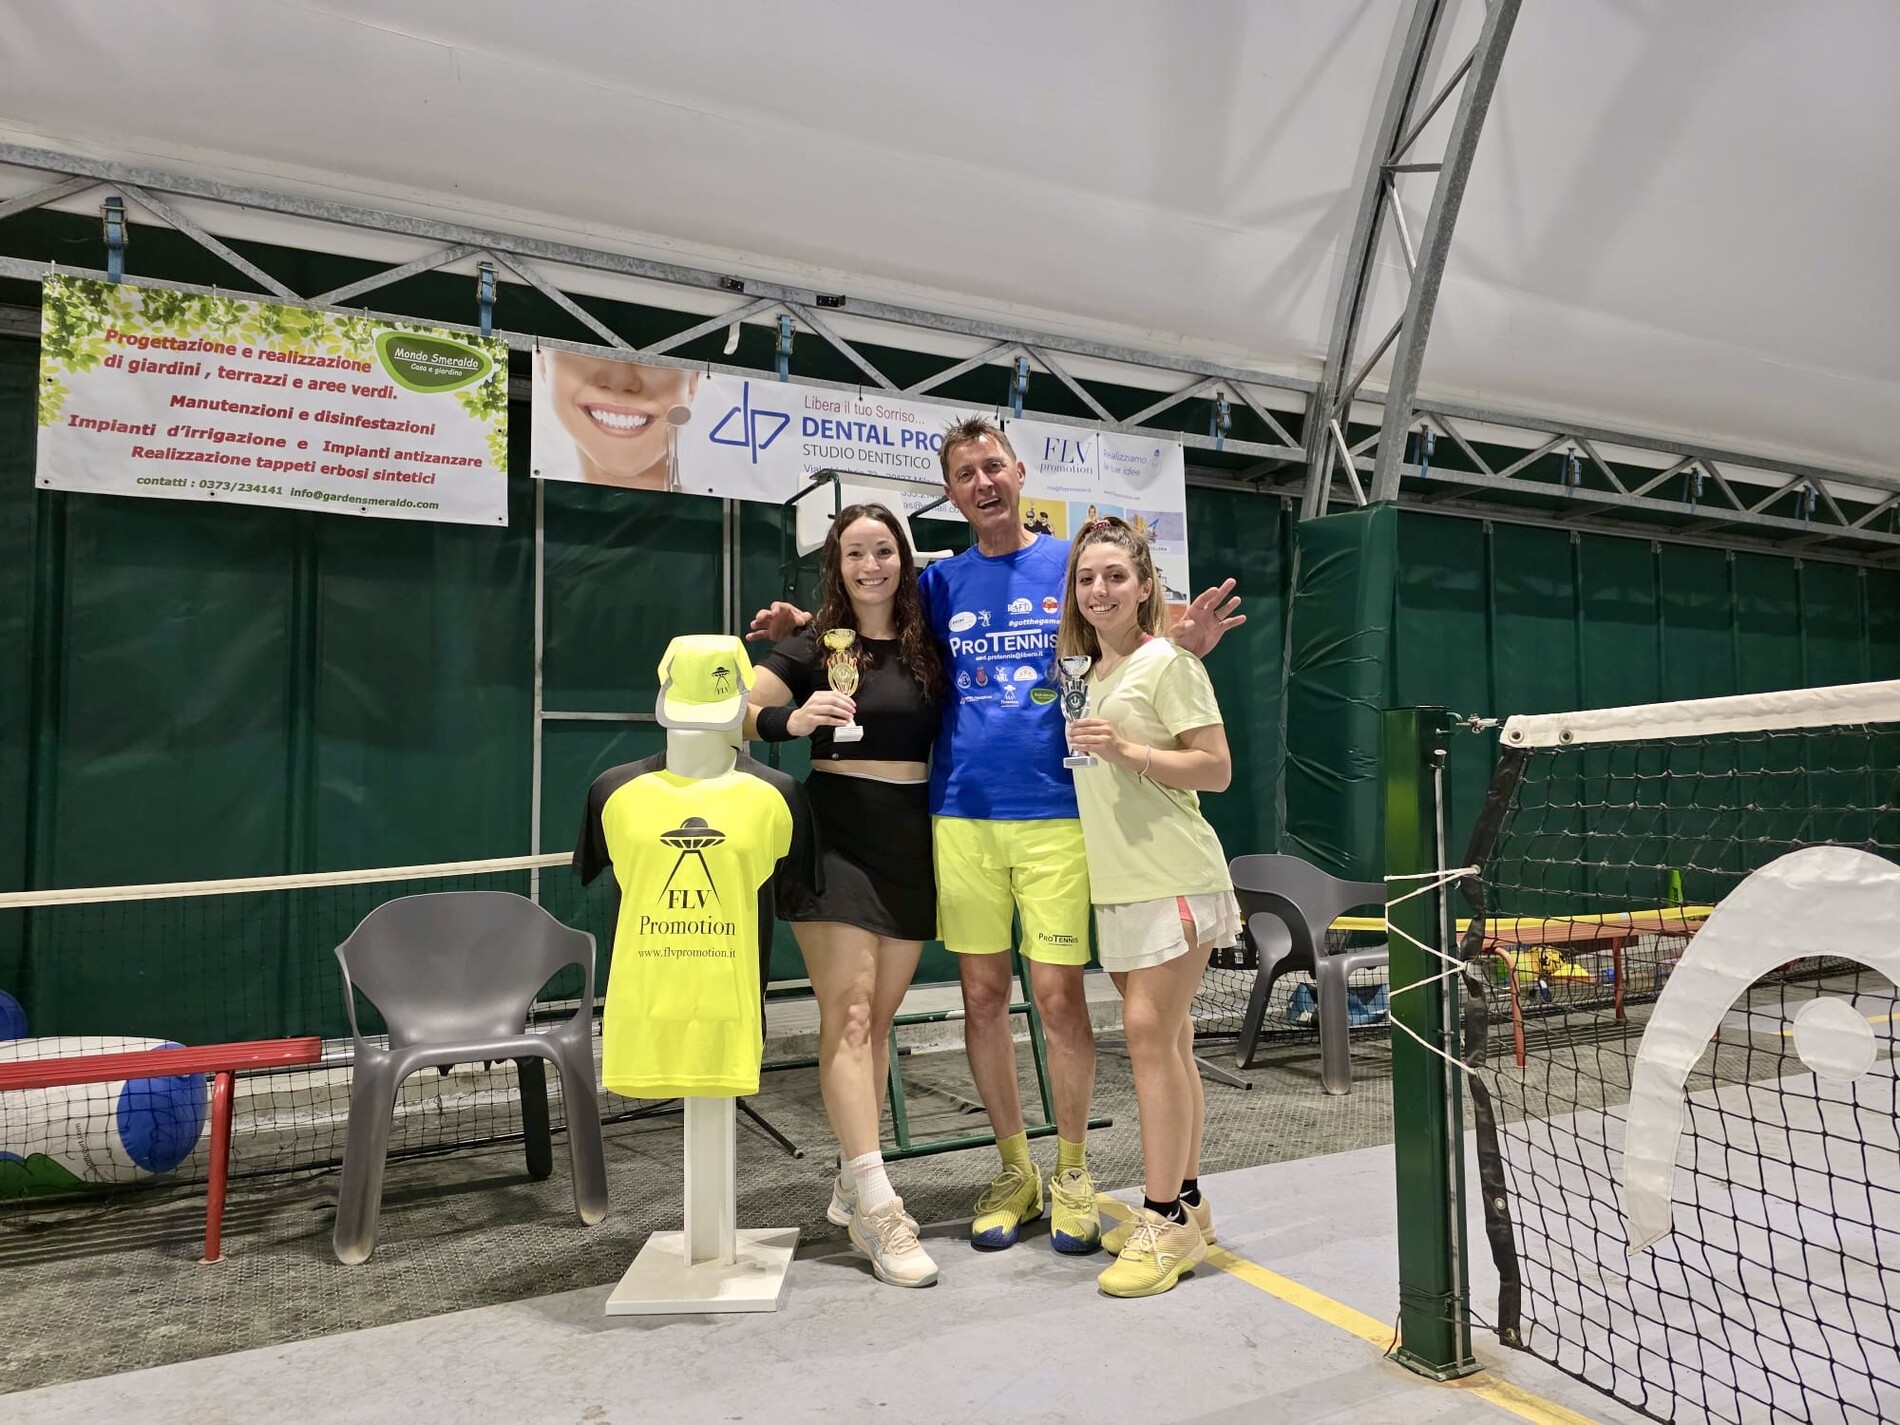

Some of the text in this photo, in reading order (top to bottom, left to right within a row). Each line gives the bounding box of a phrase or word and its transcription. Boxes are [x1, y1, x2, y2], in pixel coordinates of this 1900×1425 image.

[104, 329, 373, 373] Progettazione e realizzazione
[394, 347, 479, 368] Mondo Smeraldo
[104, 354, 123, 369] di
[128, 358, 202, 377] giardini
[217, 365, 288, 387] terrazzi
[292, 376, 304, 389] e
[308, 379, 347, 393] aree
[351, 384, 398, 400] verdi.
[411, 363, 427, 372] Casa
[434, 367, 462, 377] giardino
[169, 395, 436, 436] Manutenzioni e disinfestazioni
[804, 395, 925, 425] Libera il tuo Sorriso...
[67, 414, 157, 436] Impianti
[297, 438, 309, 450] e
[322, 440, 391, 460] Impianti
[394, 448, 483, 468] antizanzare
[802, 416, 944, 452] DENTAL PRO
[803, 444, 931, 470] STUDIO DENTISTICO
[1043, 436, 1094, 464] FLV
[1103, 449, 1148, 464] Realizziamo
[131, 446, 436, 485] Realizzazione tappeti erbosi sintetici
[1040, 463, 1094, 475] promotion
[1123, 466, 1141, 477] idee
[136, 476, 188, 488] contatti
[199, 479, 283, 496] 0373/234141
[290, 487, 440, 510] info@gardensmeraldo.com
[667, 889, 711, 910] FLV
[639, 915, 737, 936] Promotion
[638, 946, 737, 960] www.flvpromotion.it
